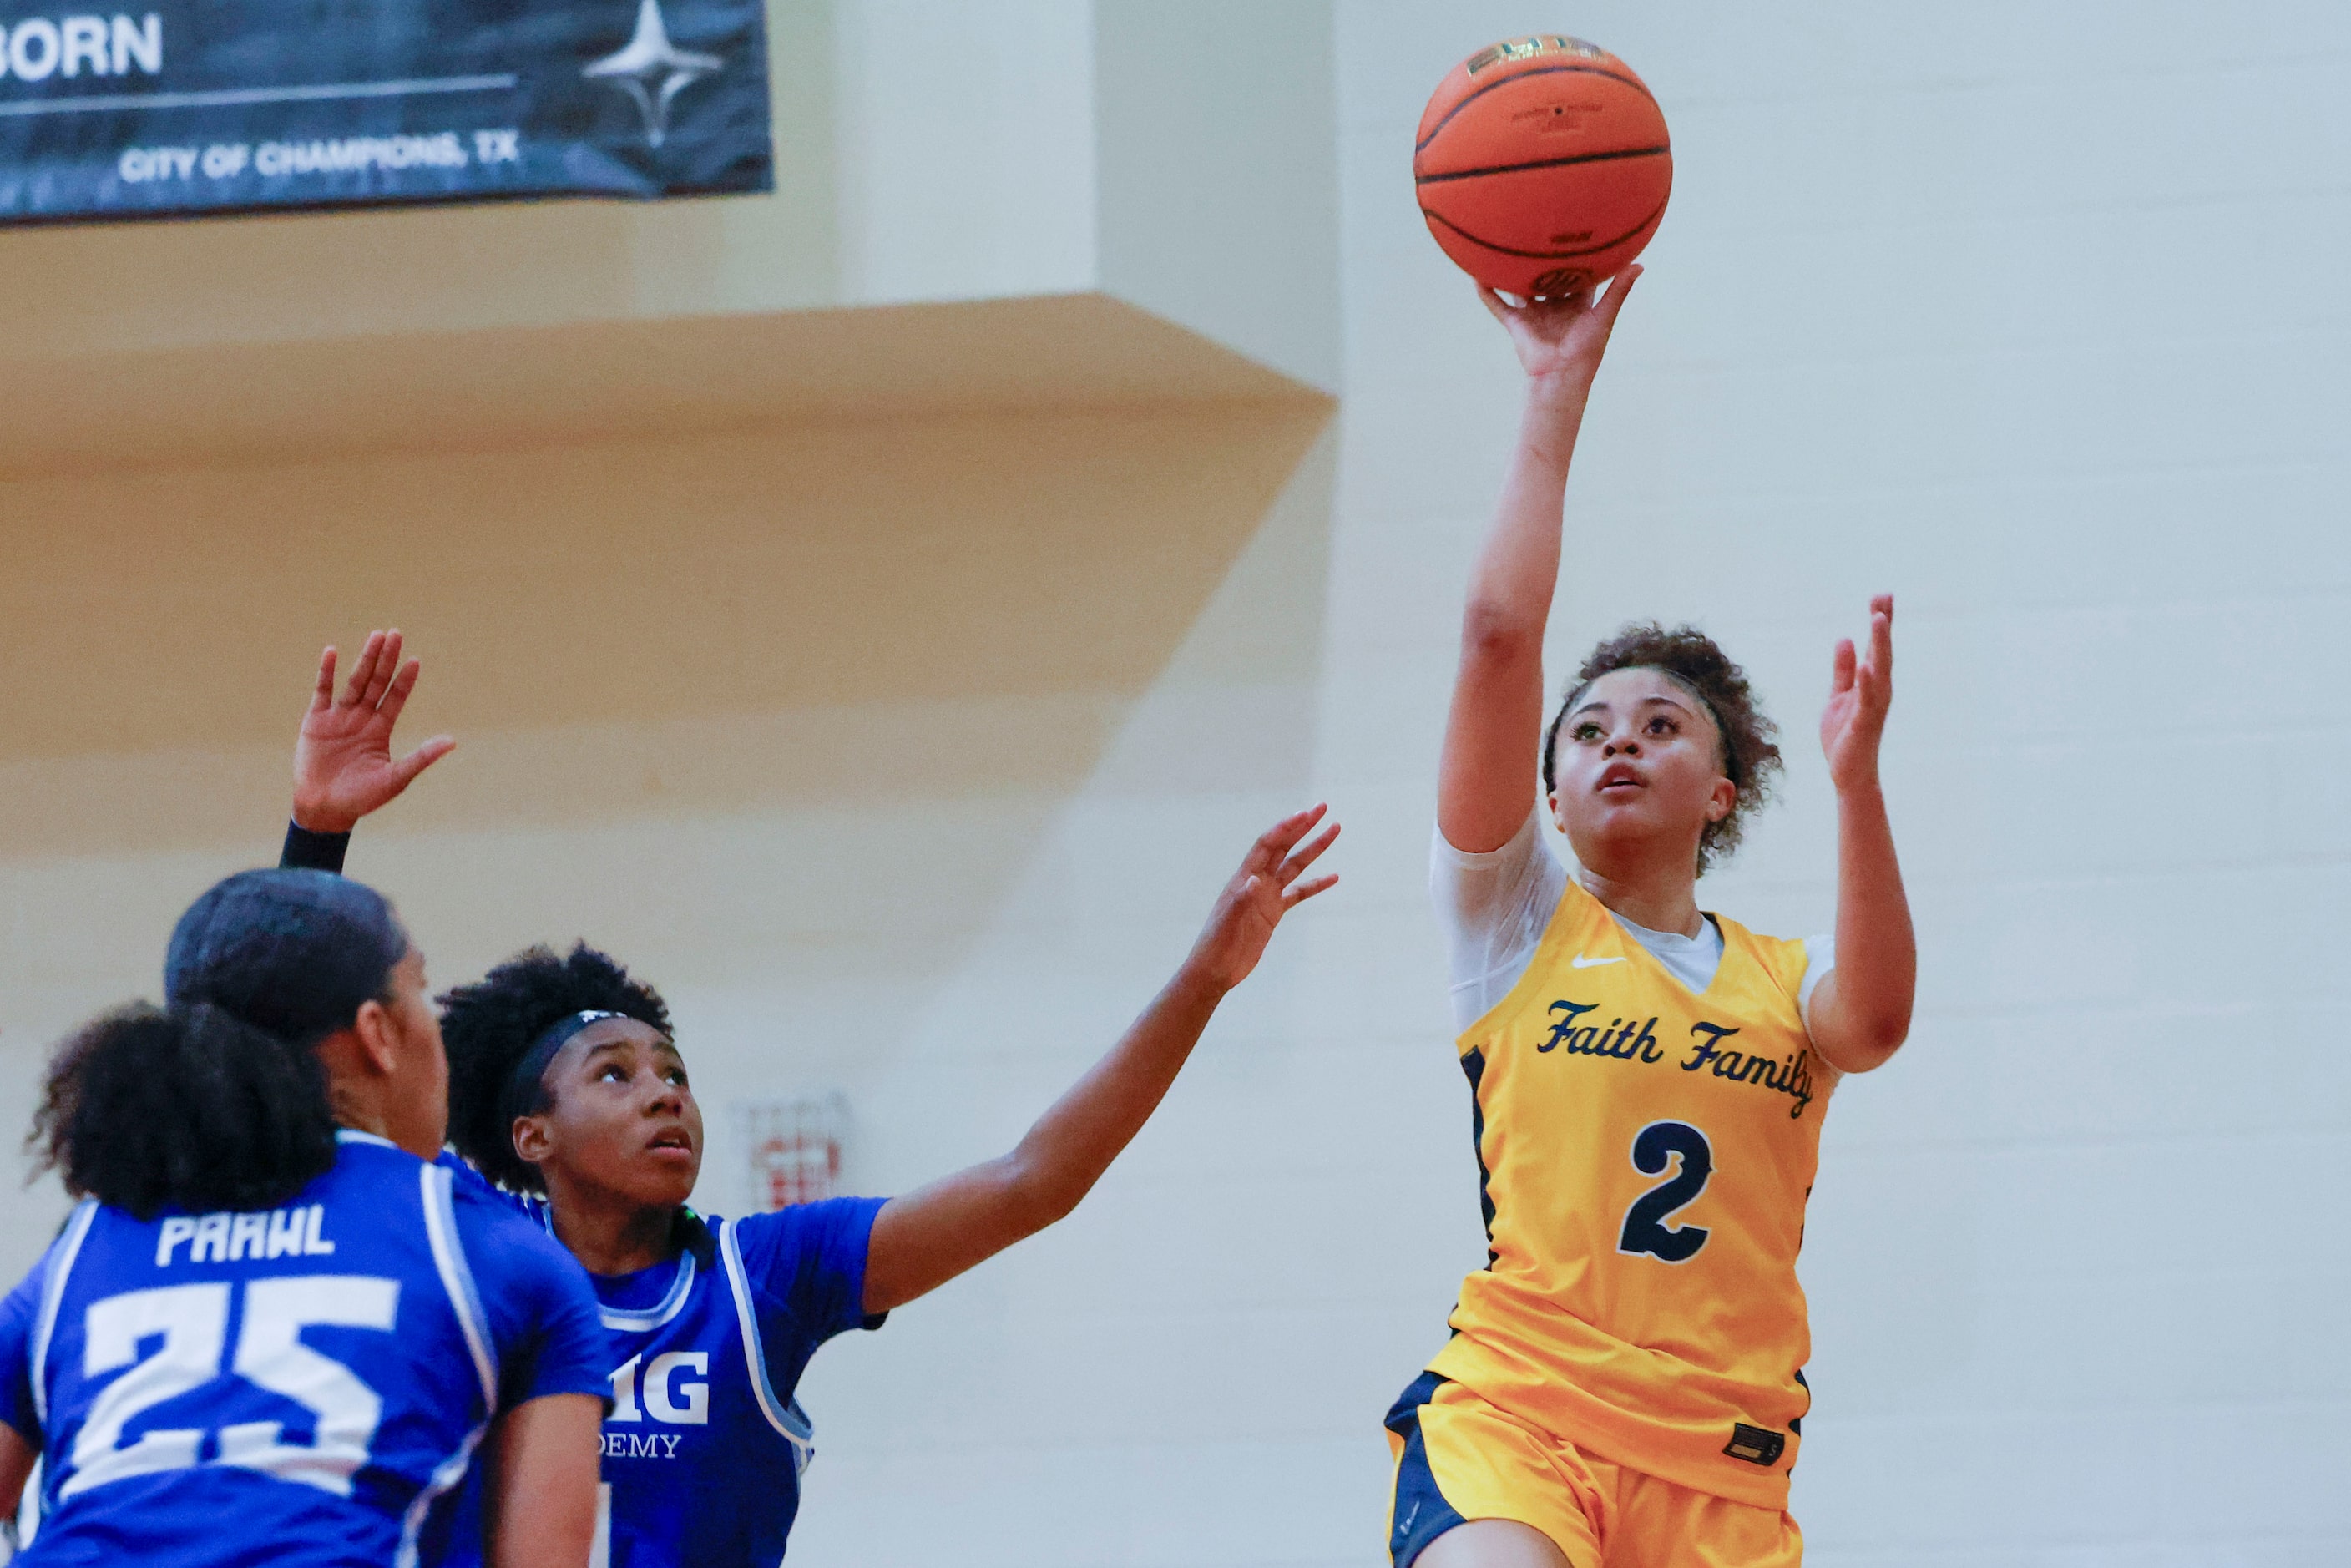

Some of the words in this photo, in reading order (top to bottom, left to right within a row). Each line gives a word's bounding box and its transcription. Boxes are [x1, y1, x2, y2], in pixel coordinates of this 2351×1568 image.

[0, 13, 163, 81] ORN
[119, 146, 198, 182] CITY
[202, 142, 250, 179] OF
[473, 129, 519, 163] TX
[1537, 999, 1663, 1064] Faith
[1681, 1021, 1813, 1119] Family
[1616, 1119, 1716, 1262] 2
[58, 1275, 401, 1500] 25
